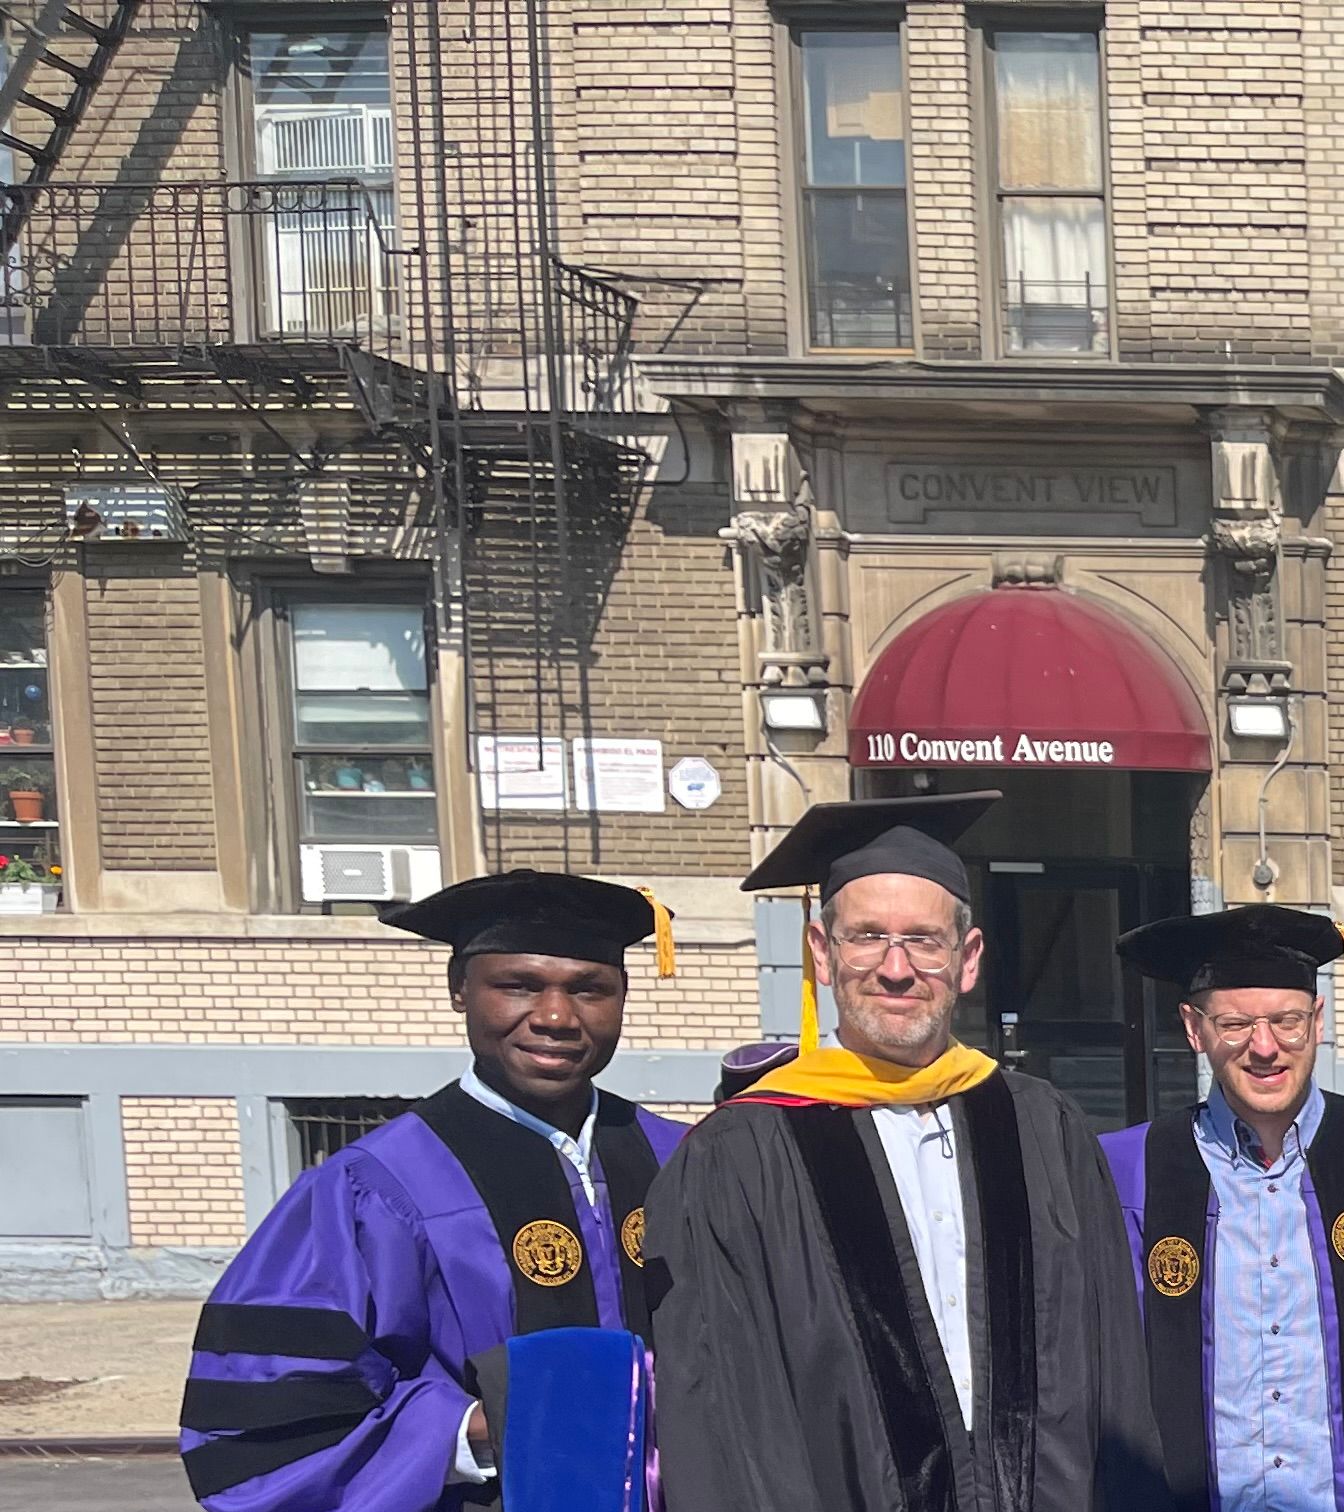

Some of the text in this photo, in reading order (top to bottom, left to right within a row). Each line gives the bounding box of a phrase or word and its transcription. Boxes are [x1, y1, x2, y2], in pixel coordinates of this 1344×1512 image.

[901, 473, 1162, 504] CONVENT VIEW
[867, 732, 1114, 763] 110 Convent Avenue
